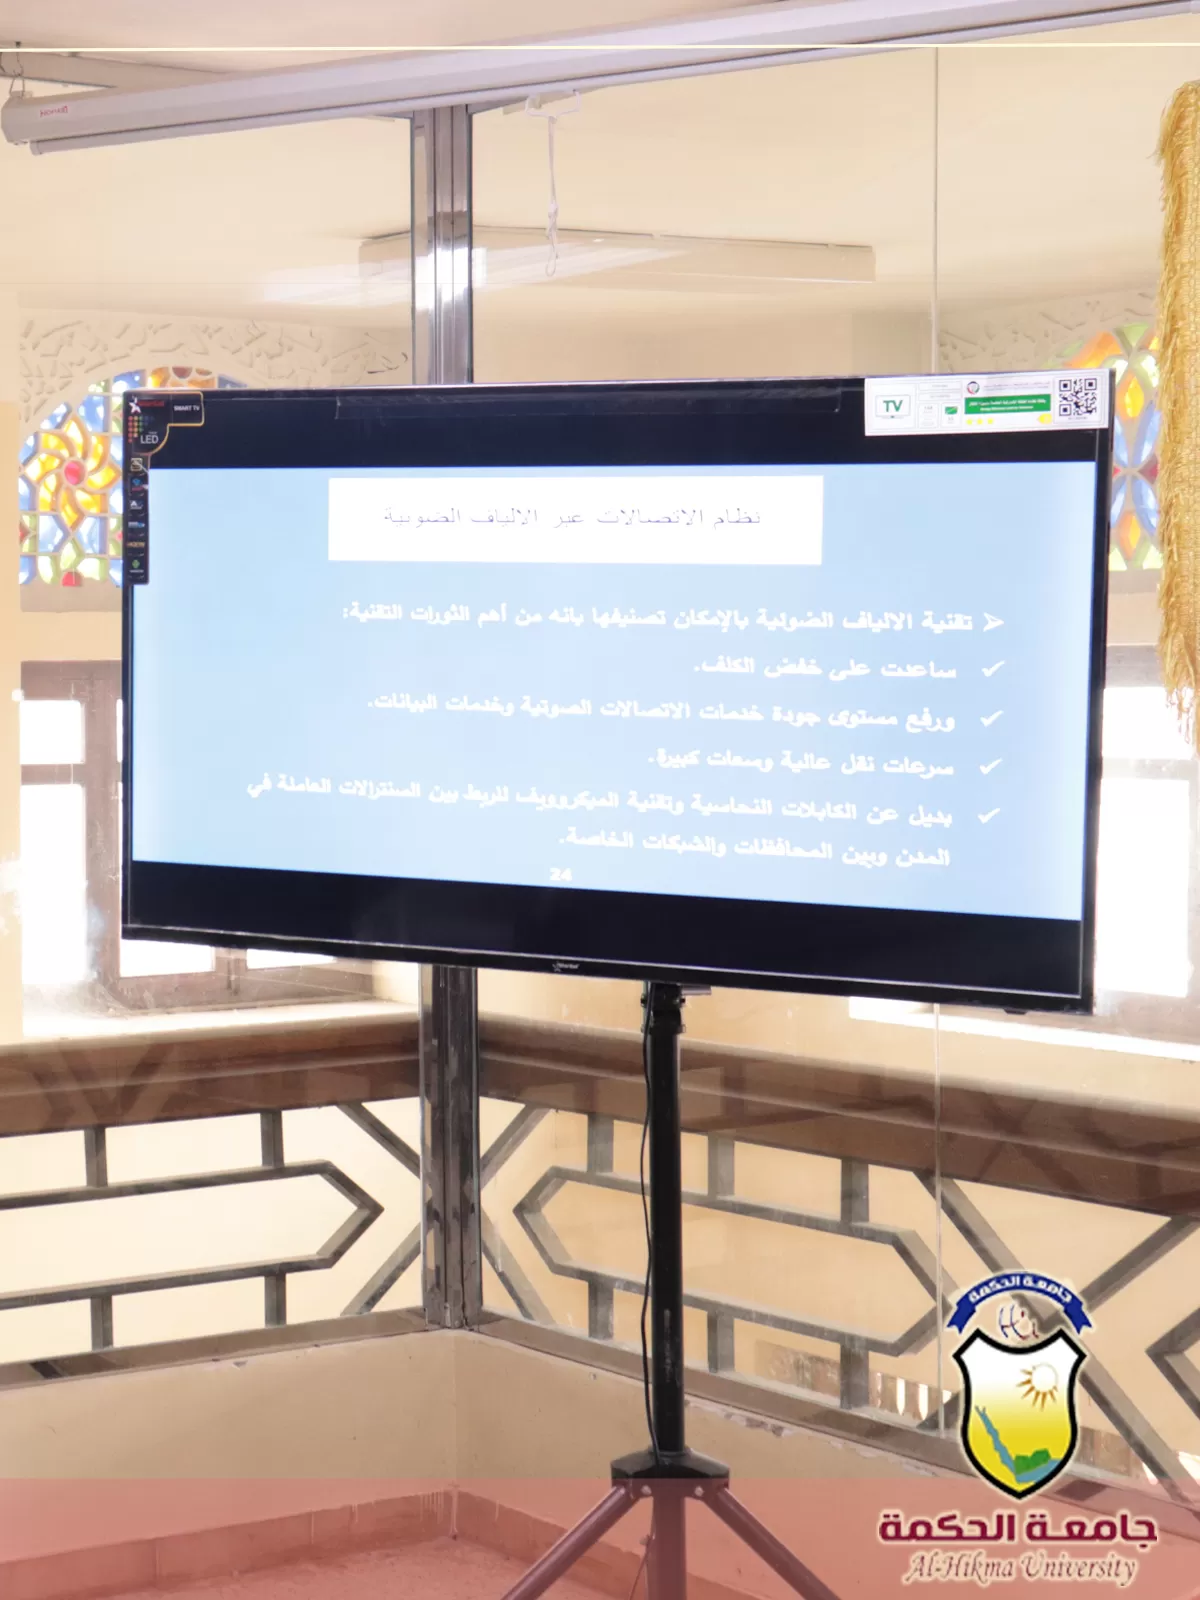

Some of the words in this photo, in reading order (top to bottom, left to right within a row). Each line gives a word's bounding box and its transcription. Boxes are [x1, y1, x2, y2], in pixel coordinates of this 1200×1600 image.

[883, 399, 903, 413] TV
[140, 434, 159, 445] LED
[470, 508, 539, 528] الالياف
[553, 511, 586, 529] عبر
[596, 508, 705, 528] الاتصالات
[714, 507, 761, 531] نظام
[410, 604, 470, 625] الثورات
[477, 602, 507, 628] أهم
[514, 608, 544, 627] من
[591, 607, 667, 628] تصنيفها
[841, 610, 914, 632] الالياف
[921, 610, 974, 634] تقنية
[693, 655, 755, 674] الكلف.
[763, 656, 823, 679] خفض
[828, 658, 871, 681] على
[367, 692, 438, 713] البيانات.
[444, 696, 515, 716] وخدمات
[519, 695, 593, 718] الصوتية
[599, 700, 691, 721] الاتصالات
[699, 703, 765, 721] خدمات
[772, 705, 821, 727] جودة
[827, 708, 898, 729] مستوى
[905, 706, 955, 733] ورفع
[648, 747, 701, 769] كبيرة.
[706, 749, 775, 773] وسعات
[779, 749, 832, 773] عالية
[840, 753, 876, 775] نقل
[882, 755, 954, 780] سرعات
[246, 771, 273, 798] في
[276, 773, 332, 793] العاملة
[338, 779, 421, 800] السنترالات
[428, 784, 459, 804] بين
[626, 790, 685, 816] وتقنية
[690, 793, 773, 816] النحاسية
[781, 800, 857, 822] الكابلات
[865, 805, 899, 824] عن
[908, 804, 953, 828] بديل
[558, 826, 634, 849] الخاصة.
[642, 833, 727, 858] والشبكات
[734, 836, 833, 860] المحافظات
[841, 845, 888, 869] وبين
[895, 847, 951, 868] المدن
[549, 867, 573, 882] 24
